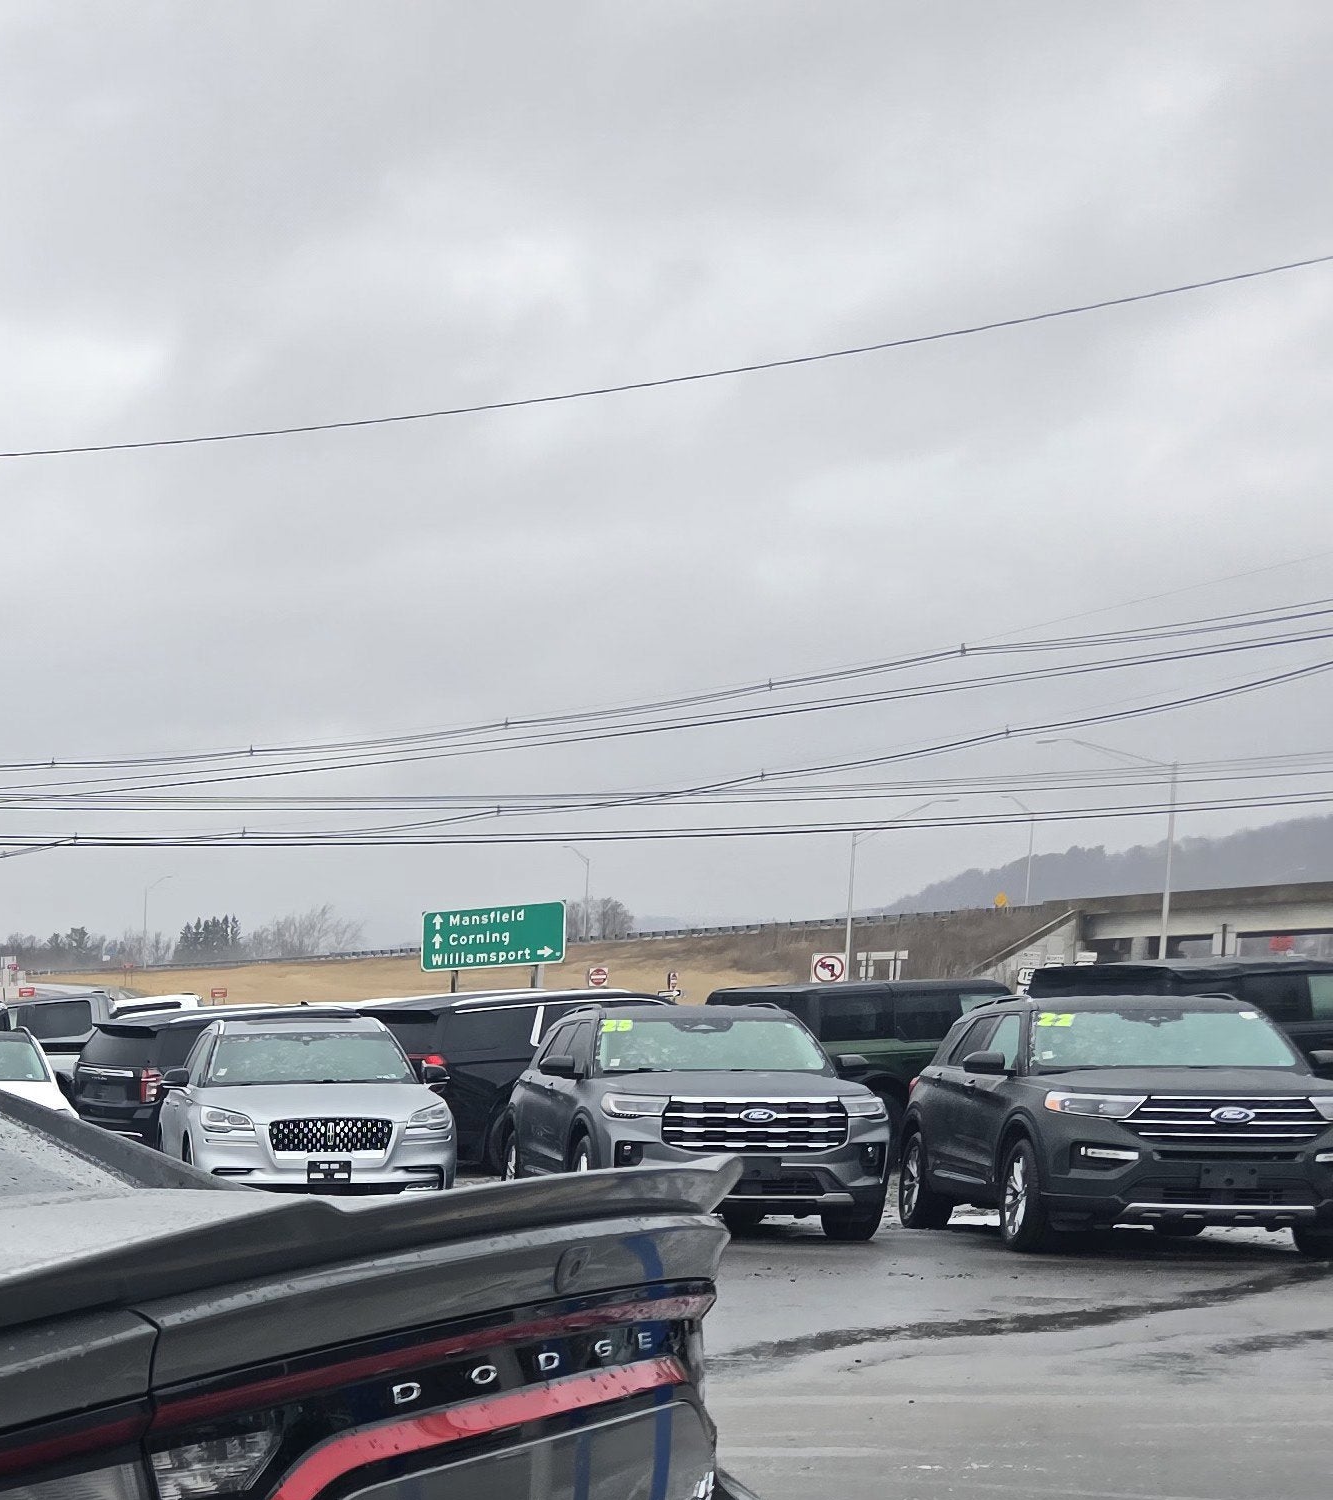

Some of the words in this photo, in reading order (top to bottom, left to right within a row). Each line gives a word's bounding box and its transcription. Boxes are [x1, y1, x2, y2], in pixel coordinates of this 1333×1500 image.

[449, 909, 525, 927] Mansfield
[449, 931, 510, 946] Corning
[431, 947, 531, 966] Williamsport
[392, 1331, 653, 1405] DODGE
